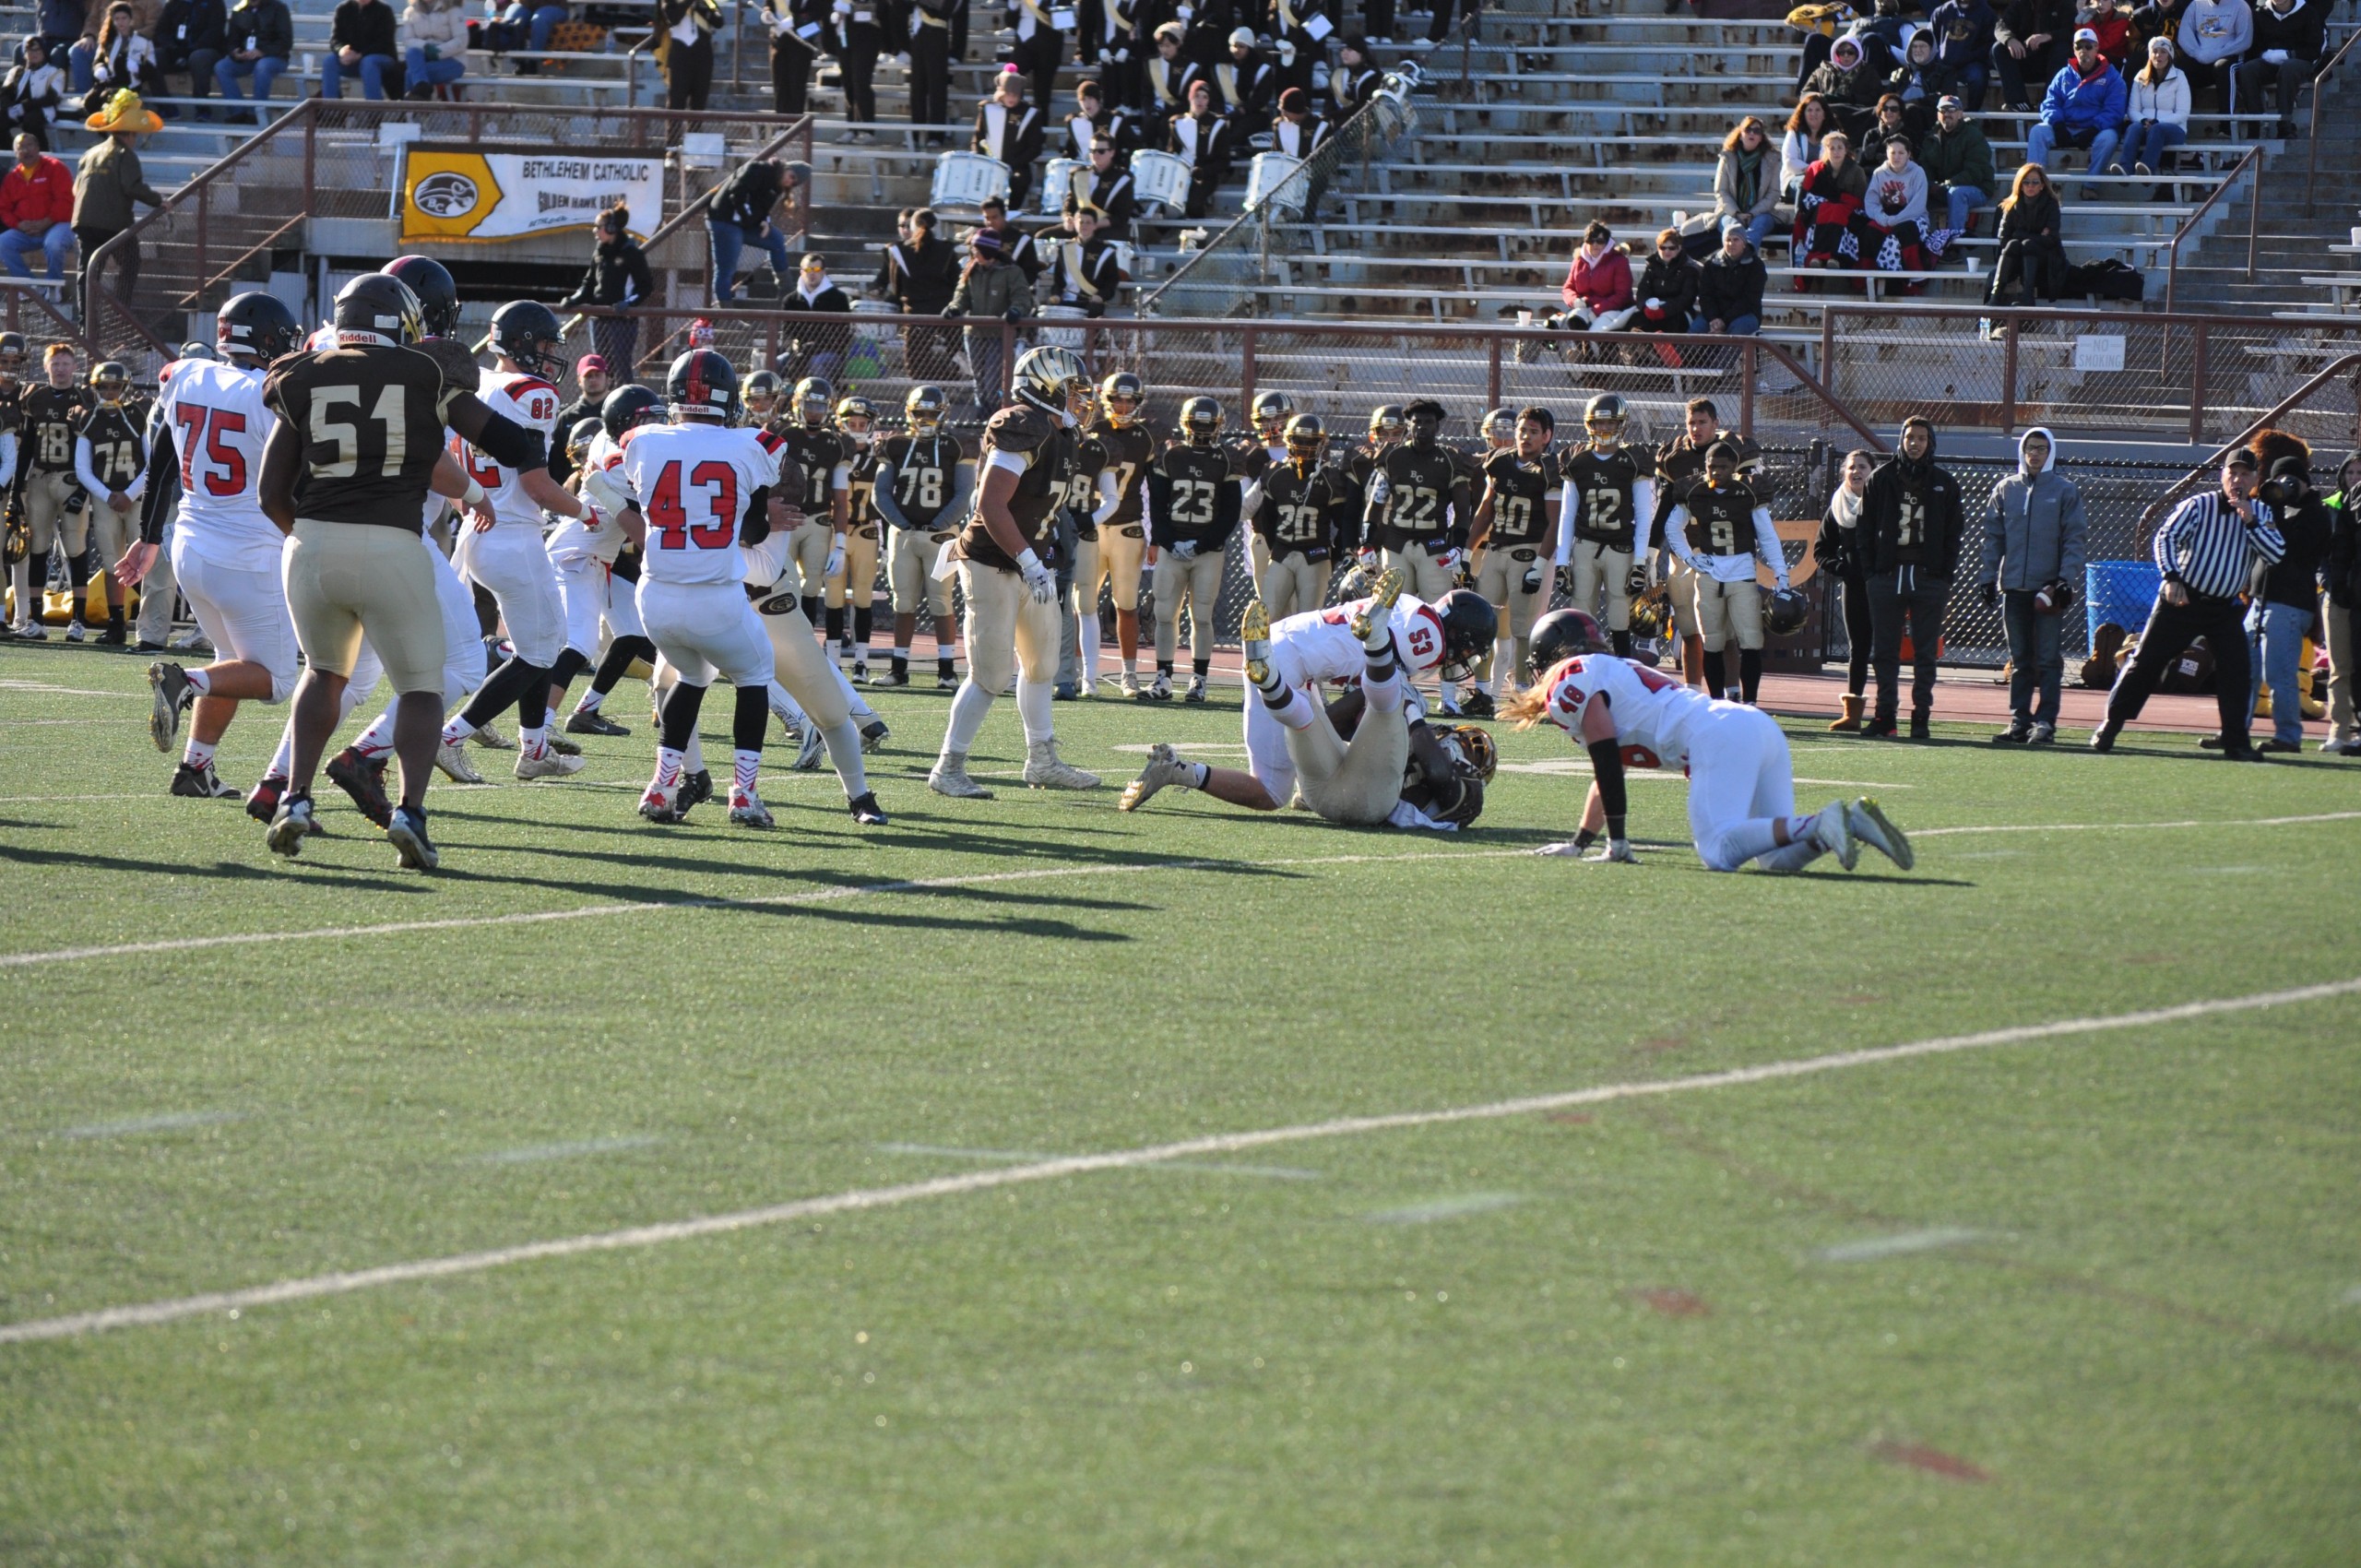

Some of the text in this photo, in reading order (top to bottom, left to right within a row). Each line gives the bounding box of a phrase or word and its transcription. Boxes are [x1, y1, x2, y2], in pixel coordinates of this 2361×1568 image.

[523, 160, 648, 182] BETHLEHEM CATHOLIC
[572, 196, 597, 209] HAWK
[339, 333, 377, 344] Riddell
[2093, 339, 2109, 352] NO
[2079, 354, 2121, 367] SMOKING
[47, 408, 59, 420] BC
[530, 398, 554, 420] 82
[678, 406, 709, 414] Riddell
[106, 428, 120, 438] BC
[308, 384, 406, 479] 51
[38, 422, 69, 463] 18
[175, 400, 247, 497] 75
[95, 441, 136, 483] 74
[801, 448, 816, 461] BC
[916, 452, 928, 464] BC
[1189, 465, 1203, 478] BC
[1410, 469, 1423, 483] BC
[1594, 472, 1608, 485] BC
[898, 467, 943, 508] 78
[1507, 479, 1518, 493] BC
[647, 459, 738, 551] 43
[1170, 480, 1216, 524] 23
[1290, 490, 1303, 503] BC
[1904, 492, 1917, 505] BC
[1394, 483, 1438, 529] 22
[1586, 488, 1621, 530] 12
[1713, 505, 1726, 518] BC
[1276, 505, 1319, 542] 20
[1897, 503, 1925, 546] 31
[1710, 520, 1735, 555] 9
[1408, 627, 1434, 657] 53
[1558, 683, 1586, 714] 48
